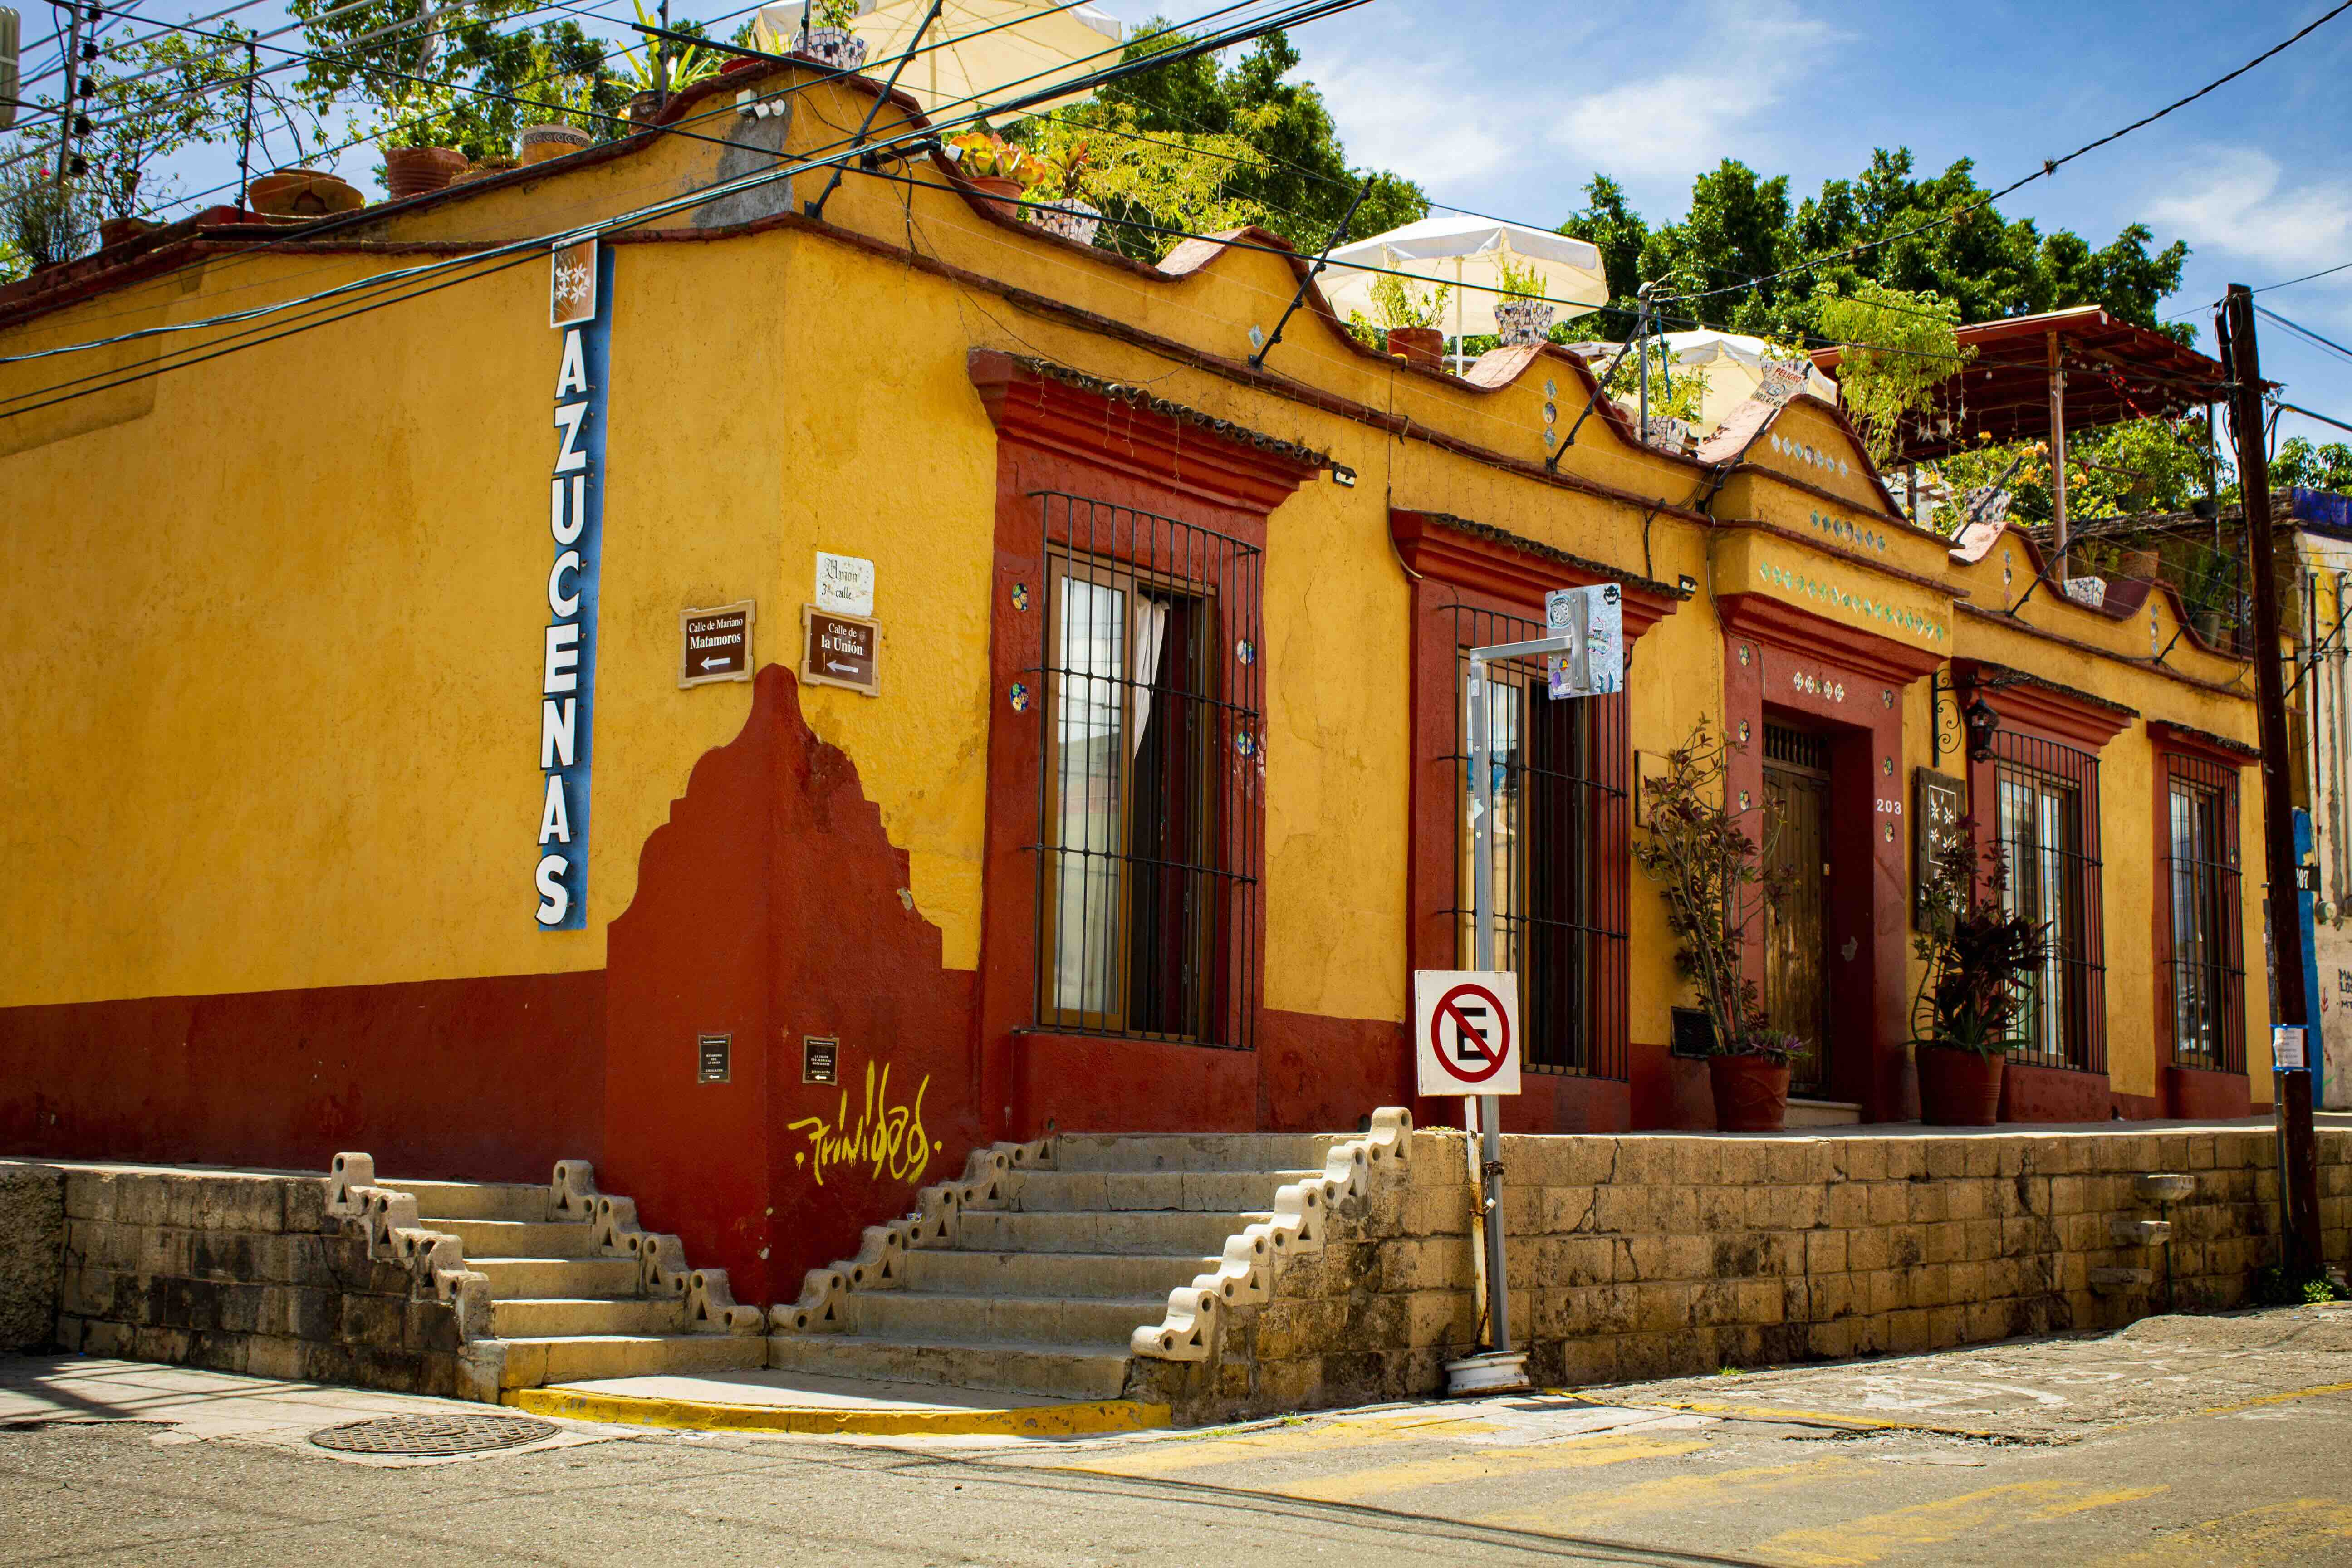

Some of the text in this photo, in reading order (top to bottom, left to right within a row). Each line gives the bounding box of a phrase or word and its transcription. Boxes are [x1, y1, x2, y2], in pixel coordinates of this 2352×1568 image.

[1775, 367, 1801, 382] PELIGRO
[835, 585, 852, 599] calle
[534, 328, 589, 926] AZUCENAS
[689, 617, 743, 633] Calle de Mariano
[828, 623, 857, 638] Calle de
[689, 633, 741, 650] Matamoros
[821, 634, 864, 656] la Unión
[1876, 798, 1901, 815] 203
